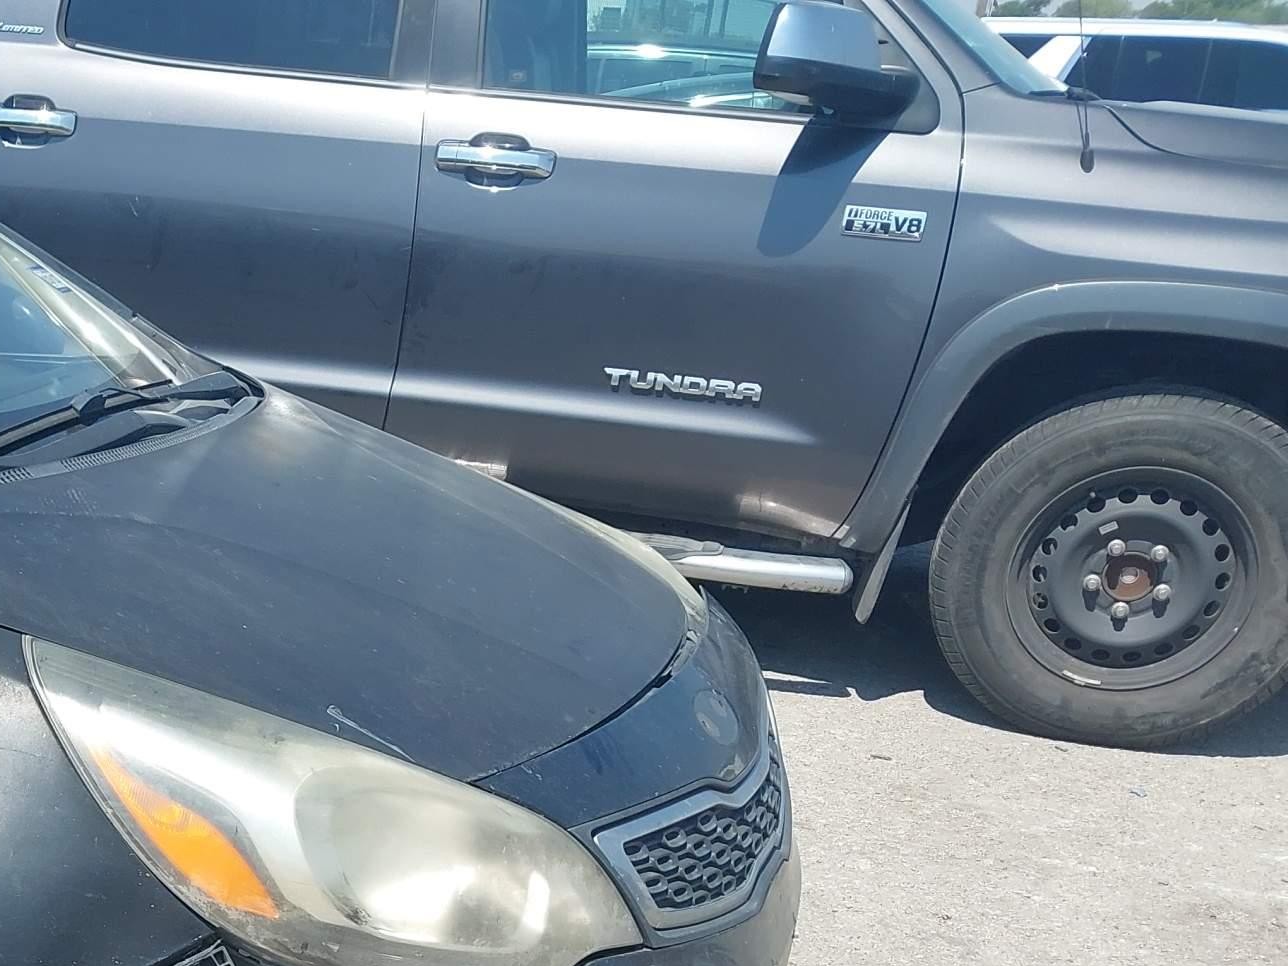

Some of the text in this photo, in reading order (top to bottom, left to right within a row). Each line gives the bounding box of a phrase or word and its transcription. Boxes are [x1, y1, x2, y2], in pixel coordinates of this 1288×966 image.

[853, 220, 886, 234] 5.7L
[893, 216, 923, 234] V8
[603, 367, 762, 402] TUNDRA
